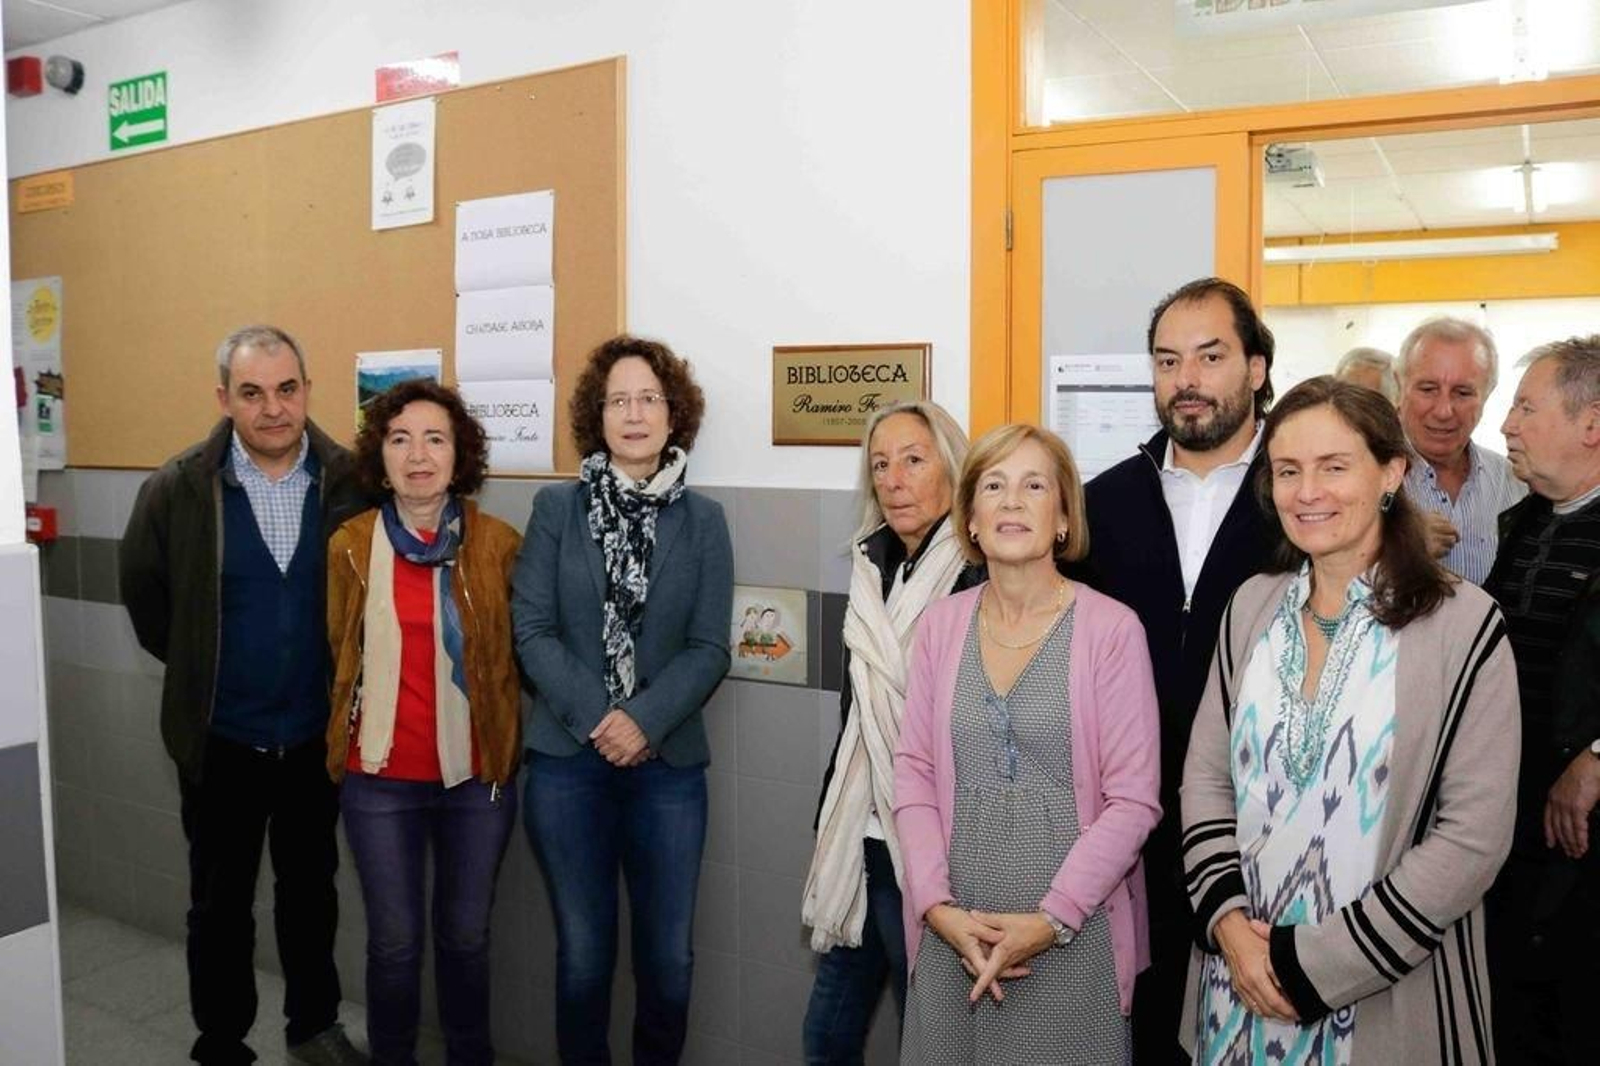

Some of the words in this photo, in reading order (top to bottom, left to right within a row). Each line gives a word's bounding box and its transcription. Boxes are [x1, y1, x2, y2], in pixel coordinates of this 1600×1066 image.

[110, 77, 165, 116] SALIDA
[461, 231, 469, 242] A
[496, 222, 548, 238] BIBLIOTECA
[787, 364, 909, 385] BIBLIOTECA
[467, 402, 540, 418] BIBLIOTECA
[792, 393, 852, 414] Ramiro
[509, 425, 540, 443] Fonte
